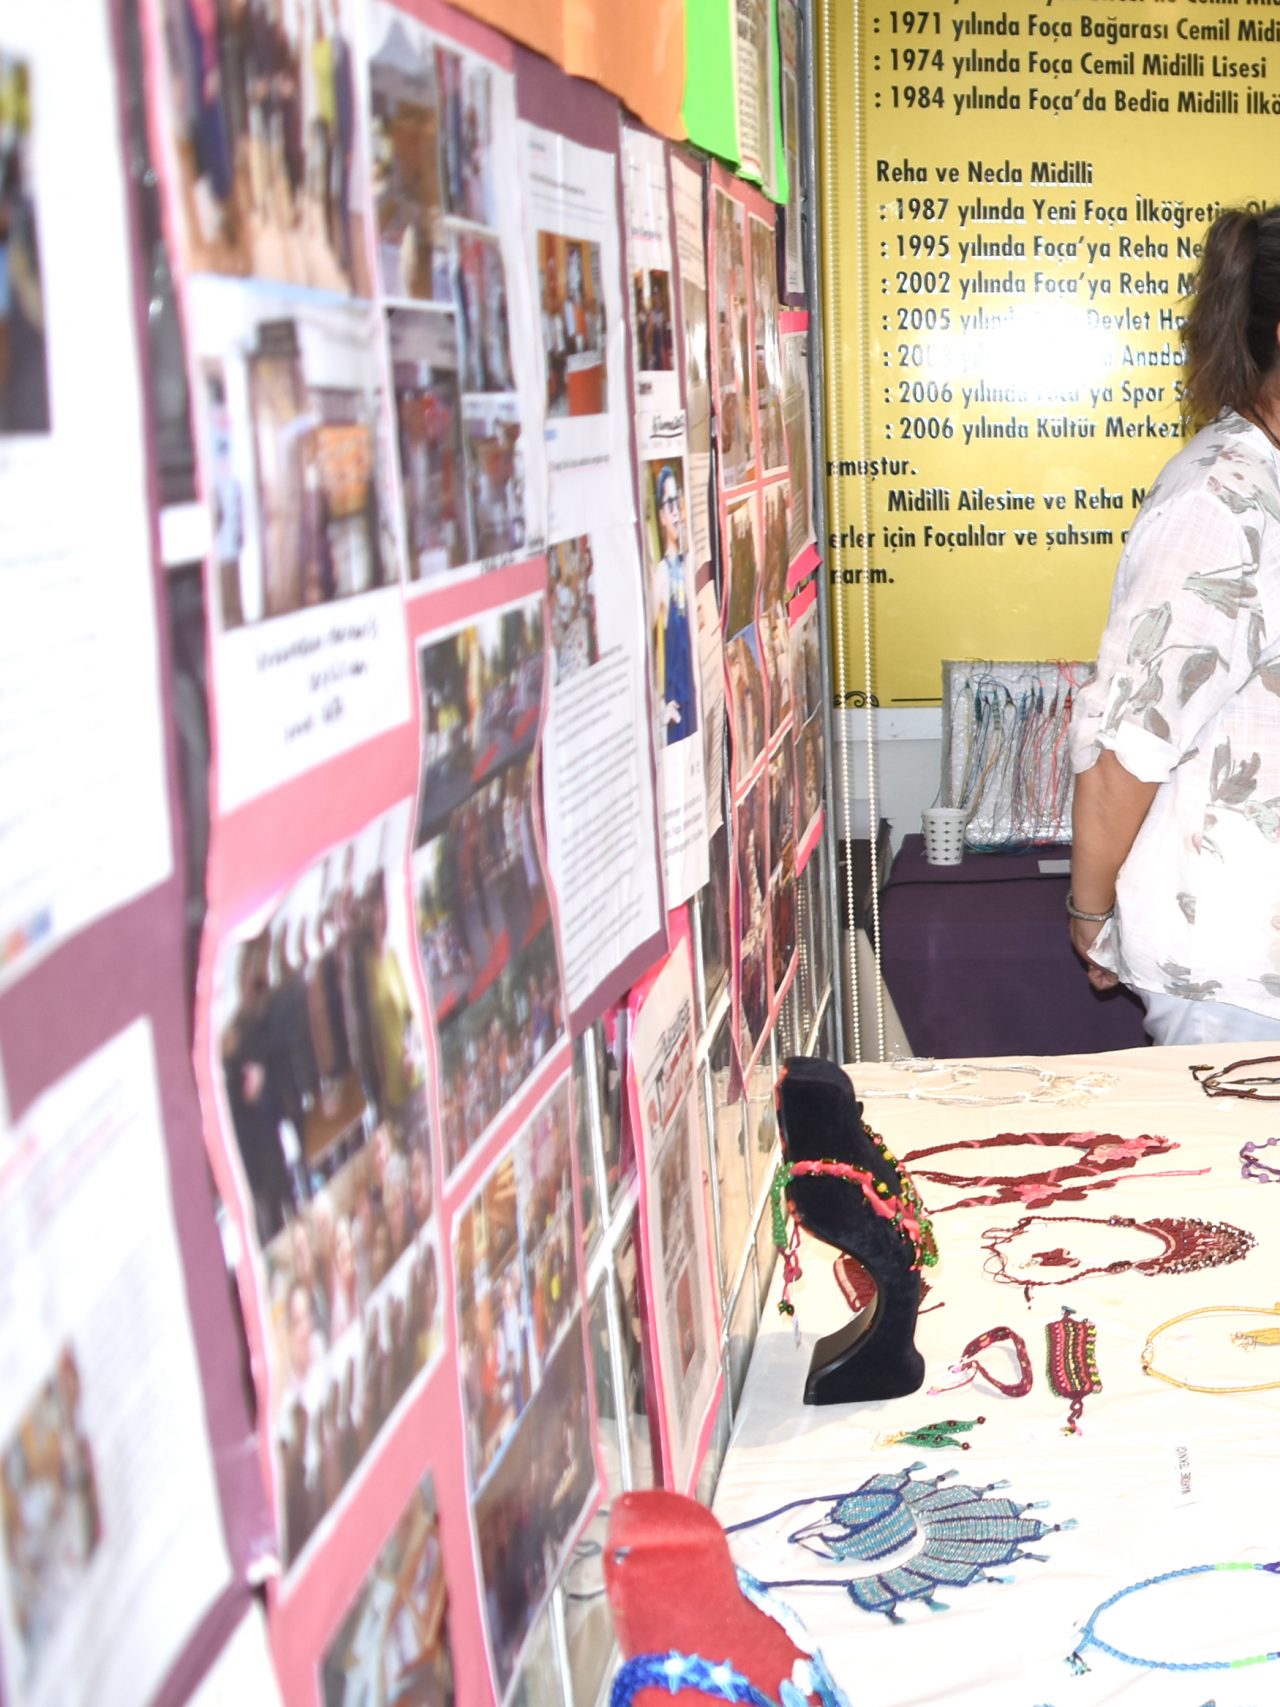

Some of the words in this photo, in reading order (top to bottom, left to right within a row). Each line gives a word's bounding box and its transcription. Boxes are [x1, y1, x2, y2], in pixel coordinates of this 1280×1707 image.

[890, 11, 941, 34] 1971
[952, 12, 1020, 41] yılında
[1028, 15, 1073, 42] Foça
[1080, 16, 1168, 45] Bağarası
[1176, 18, 1230, 41] Cemil
[890, 48, 944, 71] 1974
[952, 49, 1020, 79] yılında
[1029, 51, 1073, 79] Foça
[1080, 52, 1135, 76] Cemil
[1142, 53, 1204, 77] Midilli
[1212, 55, 1267, 78] Lisesi
[891, 86, 945, 108] 1984
[953, 86, 1020, 116] yılında
[1029, 88, 1106, 116] Foça'da
[1115, 90, 1169, 112] Bedia
[1177, 91, 1239, 113] Midilli
[876, 159, 927, 182] Reha
[936, 166, 960, 182] ve
[968, 161, 1022, 183] Necla
[1030, 161, 1093, 184] Midilli
[896, 198, 949, 220] 1987
[958, 198, 1025, 226] yılında
[1032, 199, 1076, 221] Yeni
[1084, 200, 1128, 228] Foça
[1135, 194, 1228, 228] İlköğreti
[897, 235, 949, 257] 1995
[959, 235, 1025, 263] yılında
[1033, 236, 1111, 264] Foça'ya
[1119, 236, 1168, 258] Reha
[896, 272, 951, 294] 2002
[960, 272, 1025, 300] yılında
[1119, 273, 1169, 295] Reha
[897, 308, 950, 330] 2005
[1087, 307, 1150, 330] Devlet
[899, 381, 952, 403] 2006
[1121, 380, 1165, 408] Spor
[901, 417, 954, 439] 2006
[964, 416, 1029, 445] yılında
[1037, 416, 1096, 438] Kültür
[827, 456, 917, 481] nmuştur.
[888, 489, 950, 511] Midilli
[957, 487, 1035, 511] Ailesine
[1043, 495, 1067, 510] ve
[1074, 485, 1123, 509] Reha
[828, 525, 875, 548] erler
[883, 526, 916, 552] için
[924, 524, 1006, 552] Foçalılar
[1015, 531, 1038, 546] ve
[1046, 522, 1113, 551] şahsım
[830, 566, 894, 583] narım.
